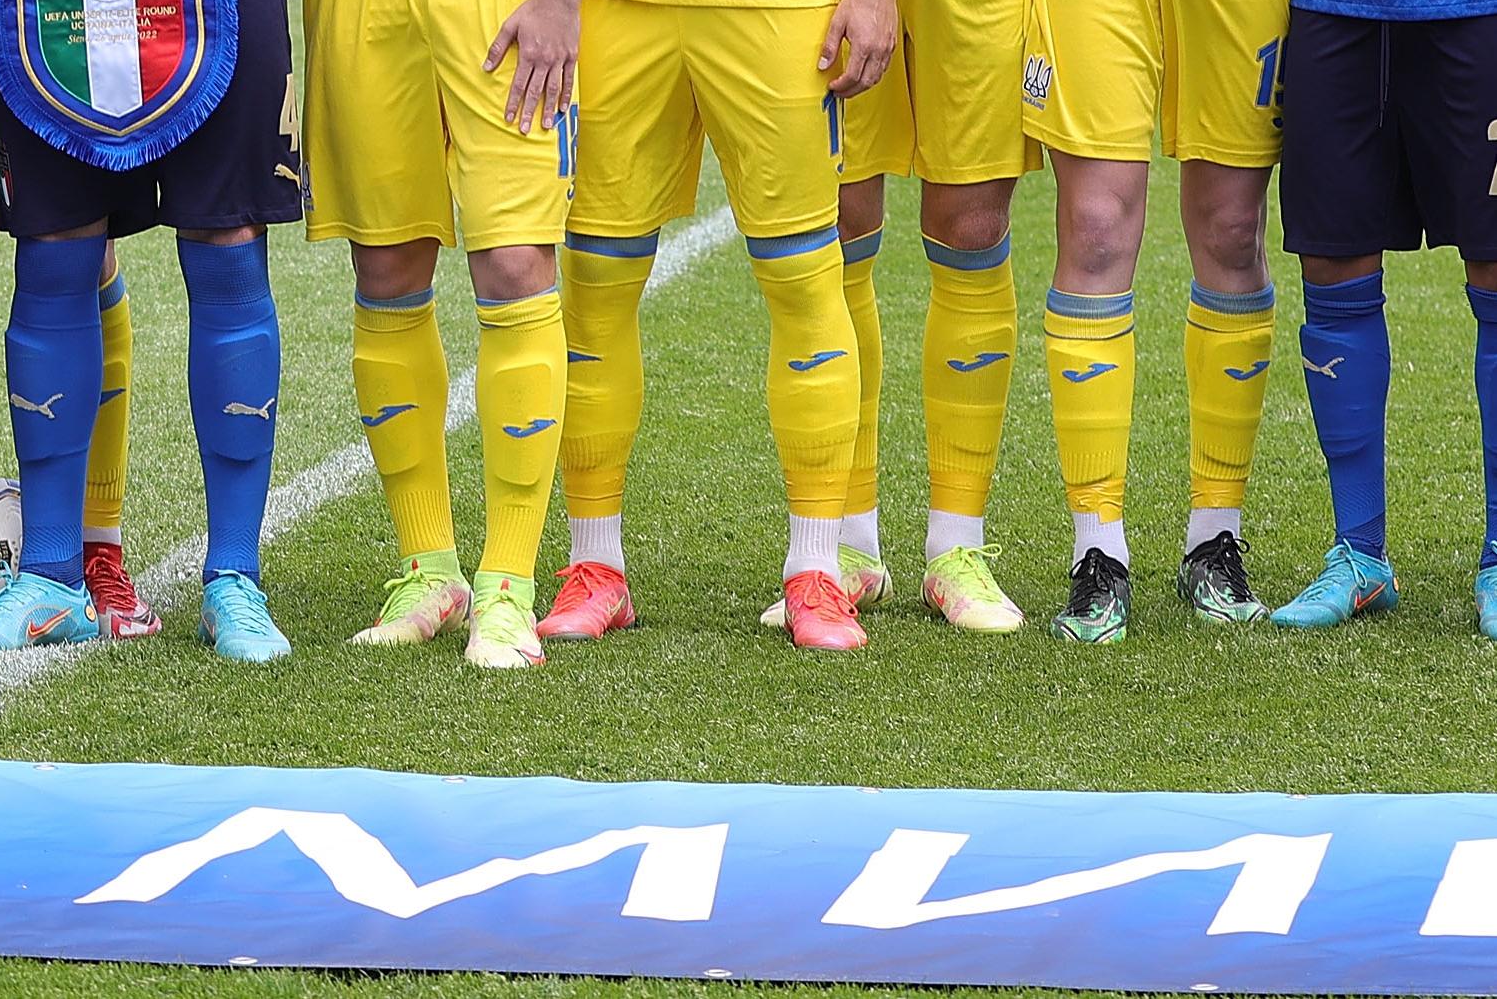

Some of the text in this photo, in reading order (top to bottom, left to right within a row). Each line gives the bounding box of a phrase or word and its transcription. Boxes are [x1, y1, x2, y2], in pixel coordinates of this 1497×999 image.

[44, 11, 69, 22] UEFA
[143, 5, 177, 16] ROUND
[1254, 36, 1287, 108] 1
